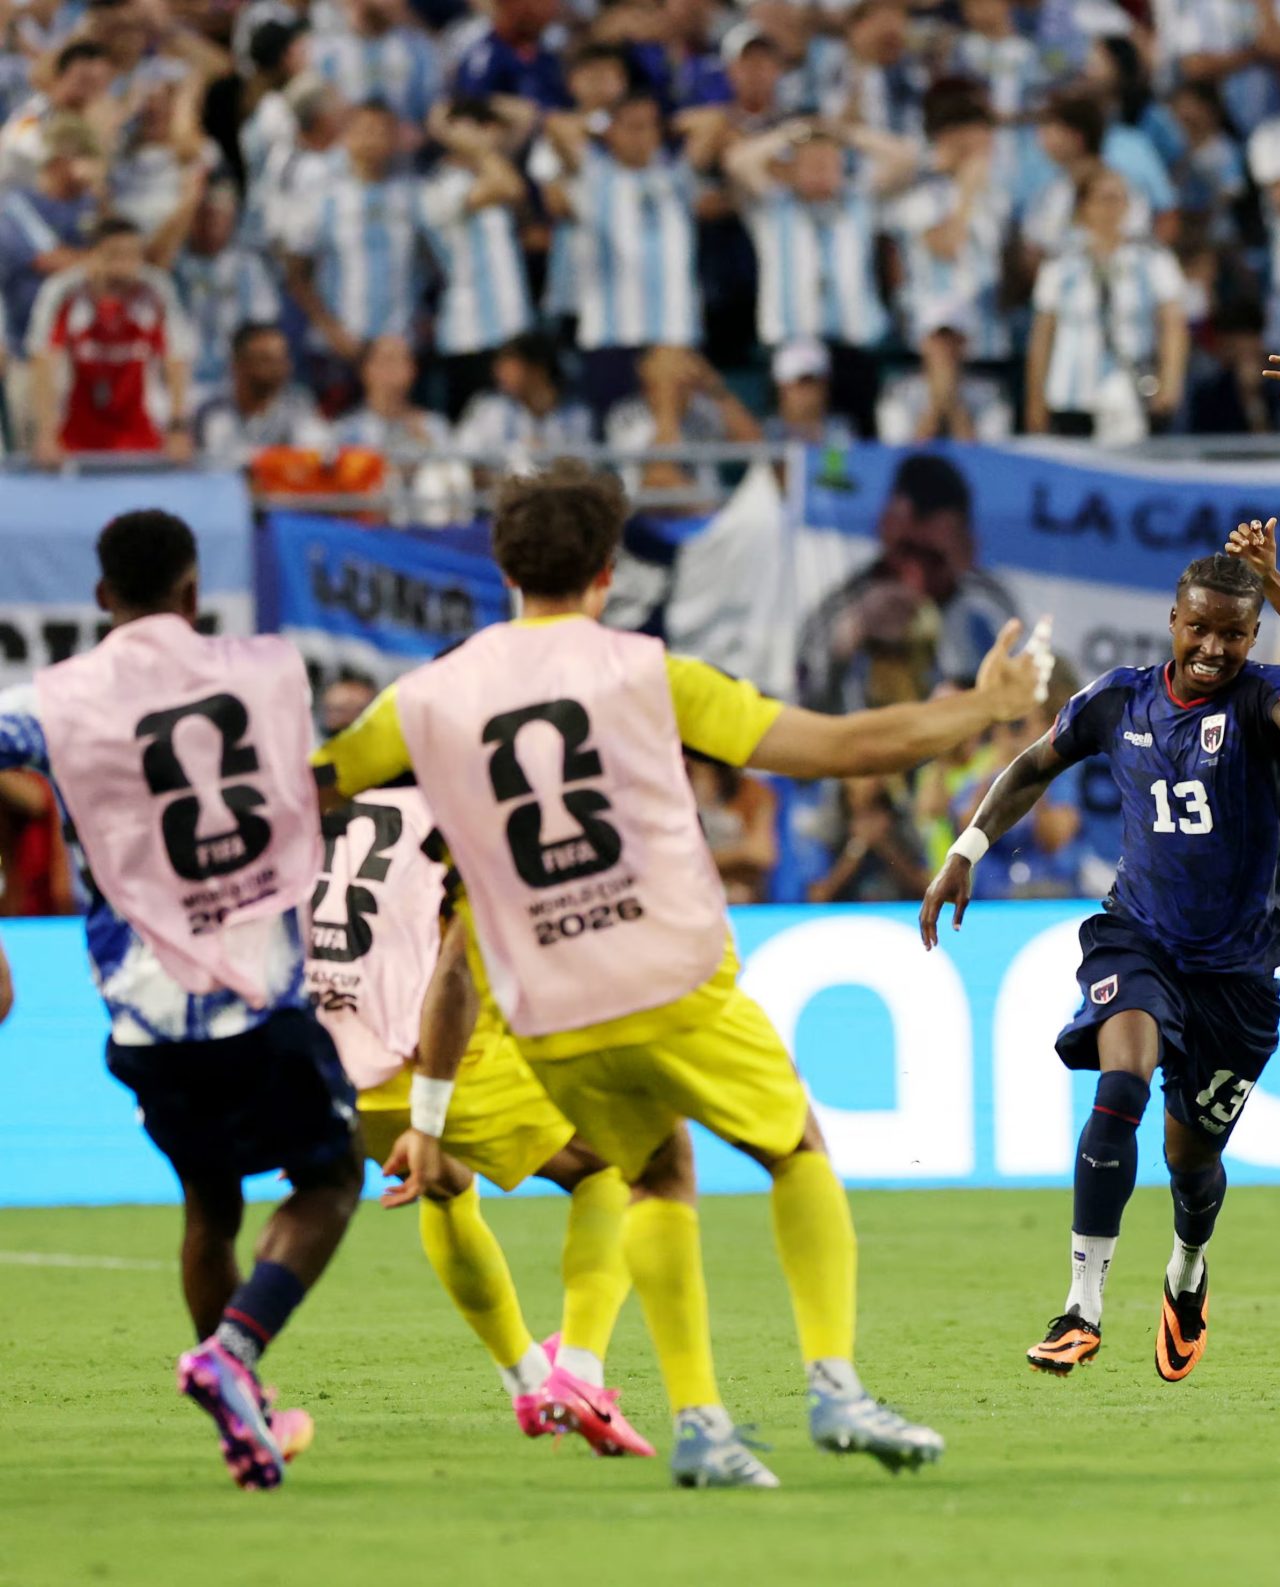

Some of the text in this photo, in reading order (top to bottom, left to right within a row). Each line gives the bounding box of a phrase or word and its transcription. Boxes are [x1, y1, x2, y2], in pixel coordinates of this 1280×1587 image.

[1151, 780, 1214, 834] 13
[541, 838, 598, 874] FIFA
[535, 897, 643, 947] 2026
[1196, 1069, 1255, 1123] 13
